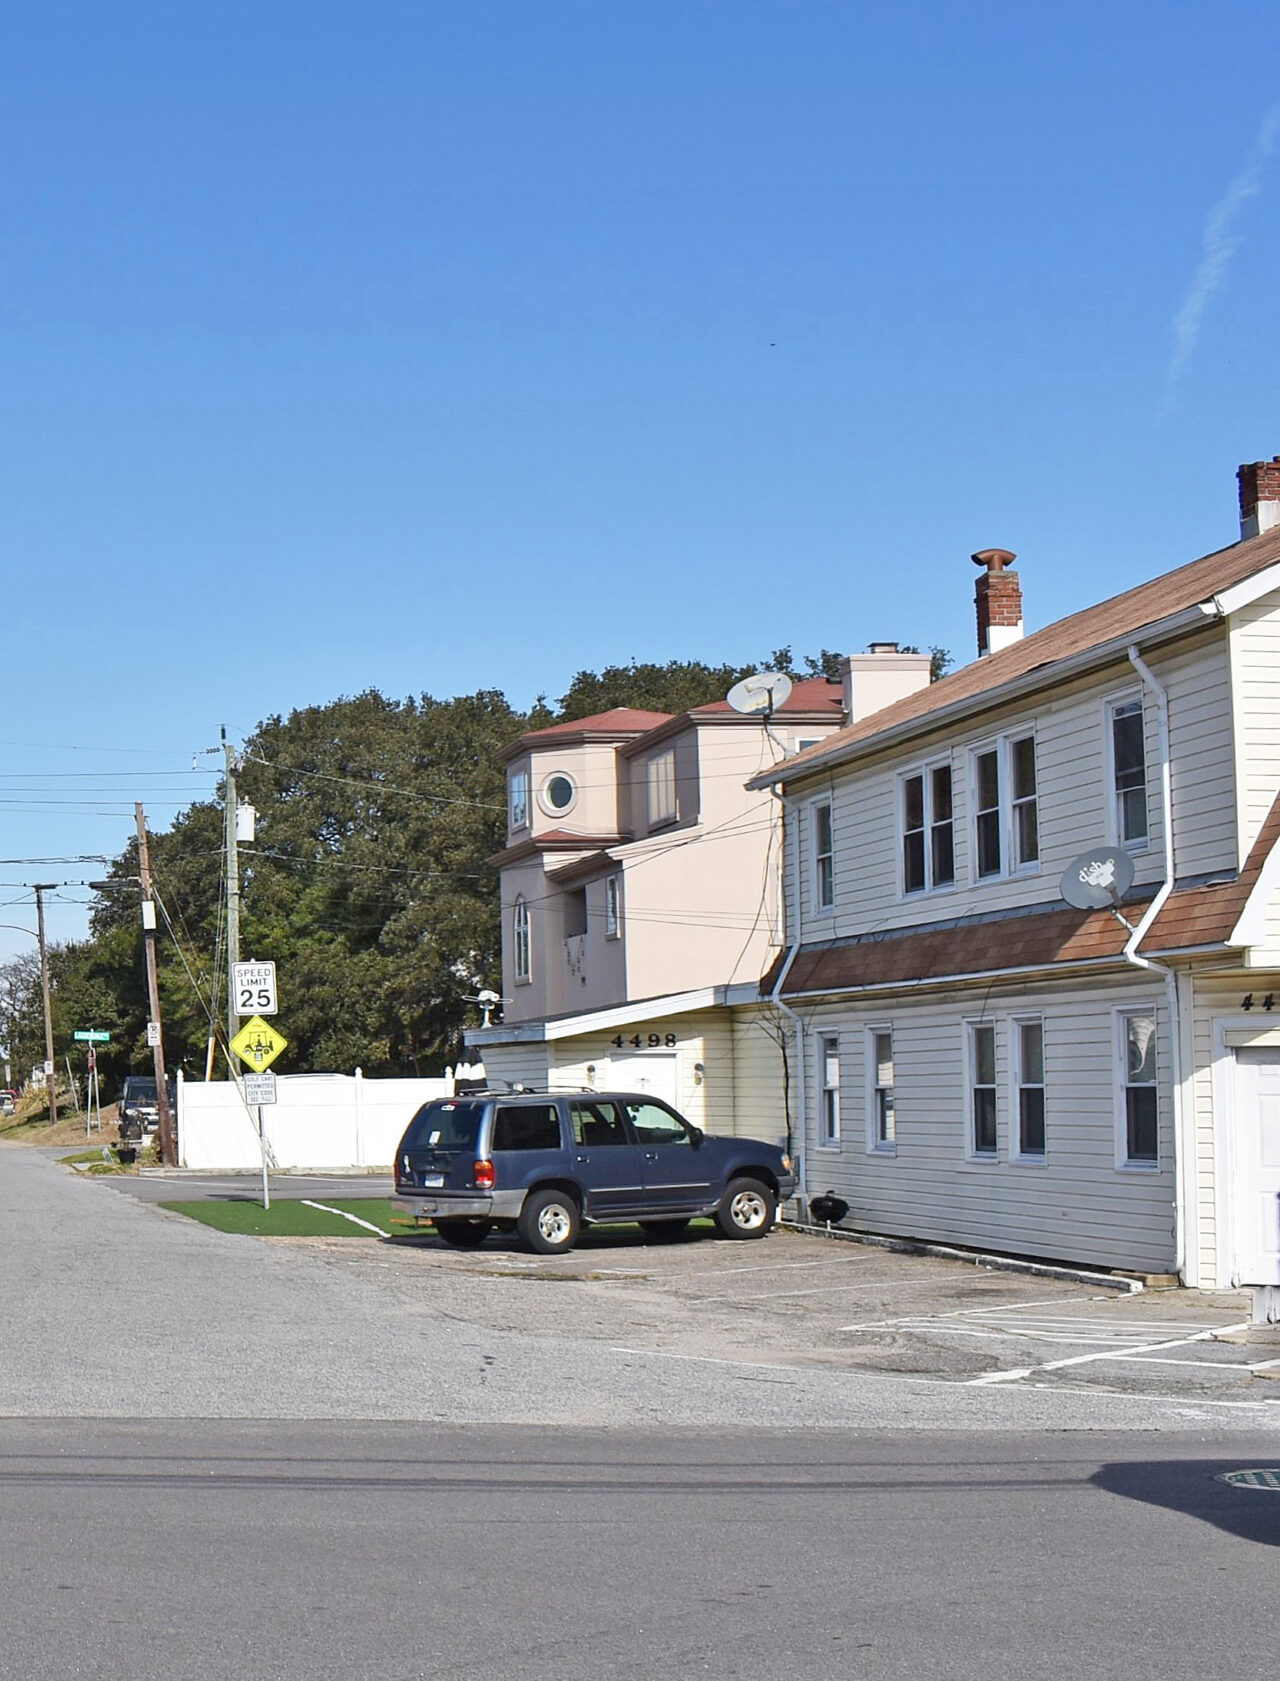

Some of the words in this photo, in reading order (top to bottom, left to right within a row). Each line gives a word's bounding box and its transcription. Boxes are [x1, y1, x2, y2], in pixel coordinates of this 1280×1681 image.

[237, 968, 271, 977] SPEED
[240, 978, 267, 987] LIMIT
[240, 989, 271, 1007] 25
[611, 1033, 676, 1048] 4498
